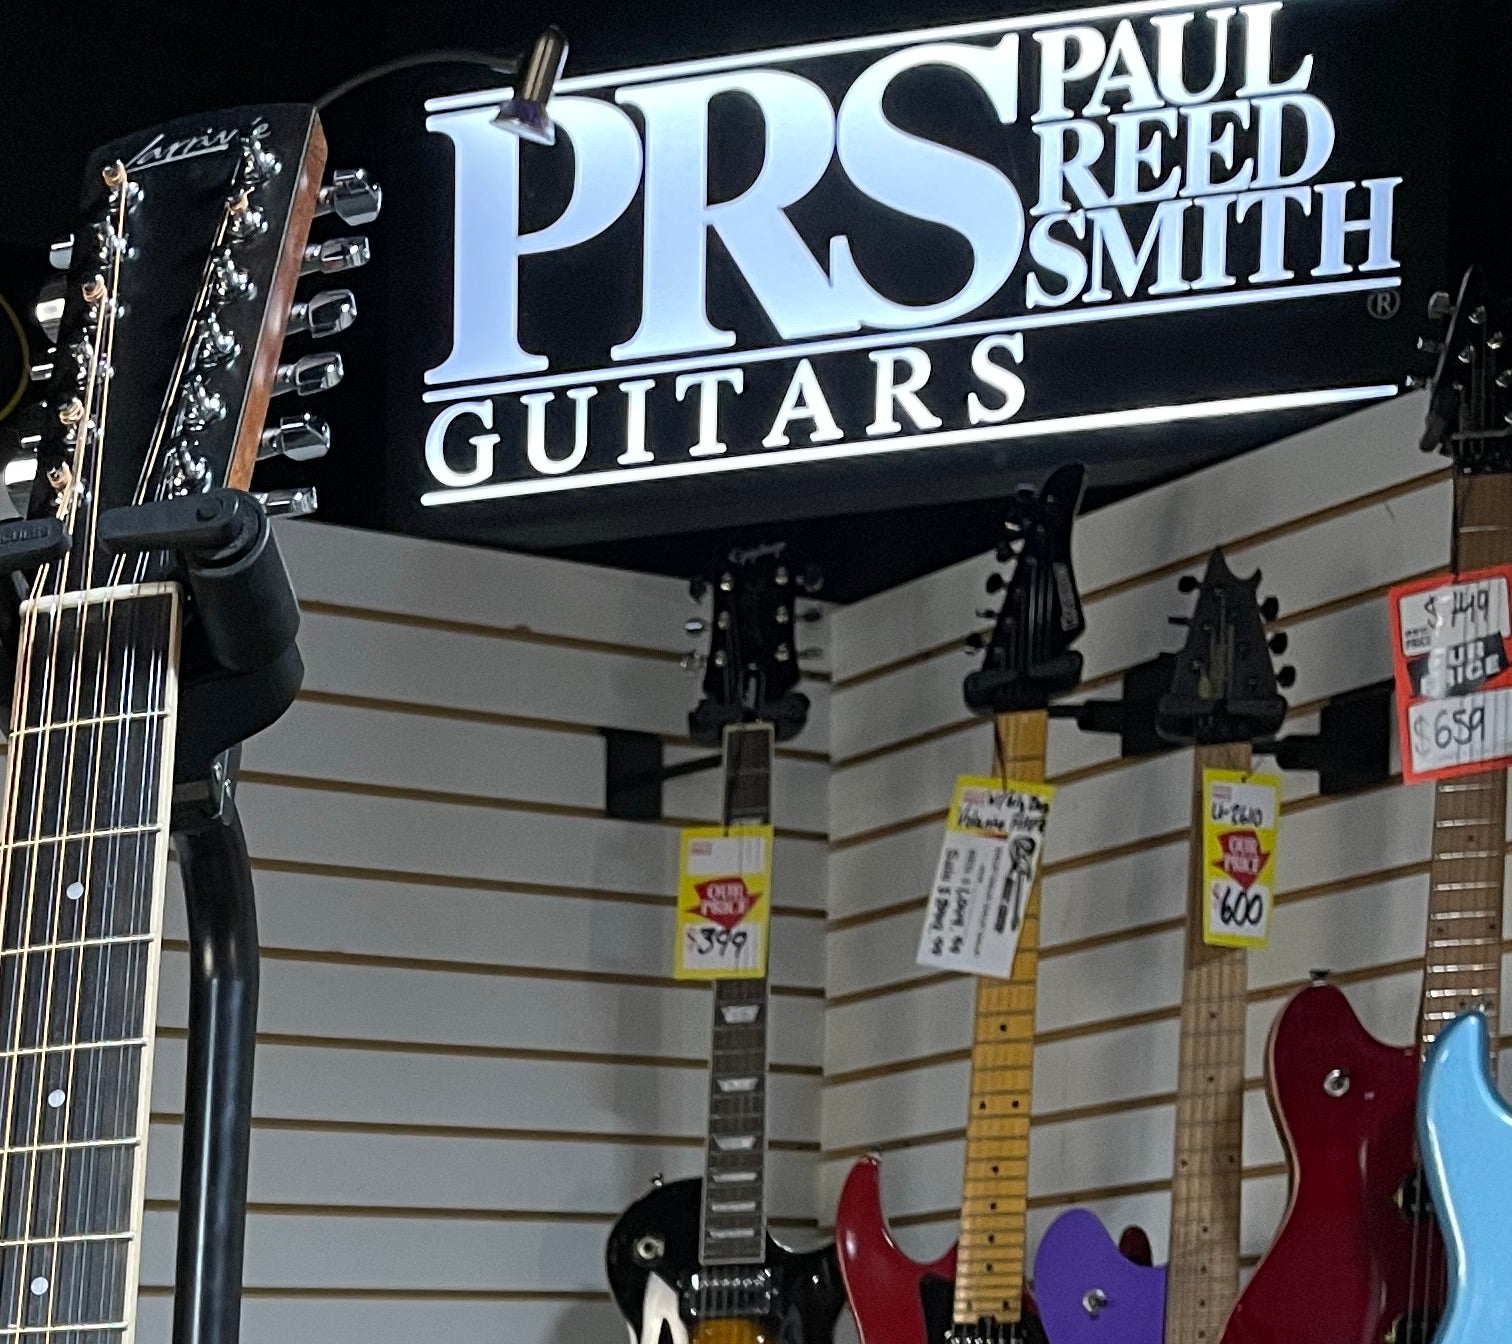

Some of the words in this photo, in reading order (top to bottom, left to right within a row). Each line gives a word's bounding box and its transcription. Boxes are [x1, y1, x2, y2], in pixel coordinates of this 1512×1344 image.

[1031, 2, 1314, 123] PAUL
[1030, 92, 1336, 216] REED
[425, 32, 1025, 387] PRS
[1025, 176, 1402, 310] SMITH
[423, 332, 1026, 488] GUITARS
[1414, 706, 1486, 758] $659
[1224, 853, 1260, 874] PRICE
[1228, 834, 1259, 853] OUR
[700, 897, 750, 916] PRICE
[706, 882, 745, 901] OUR
